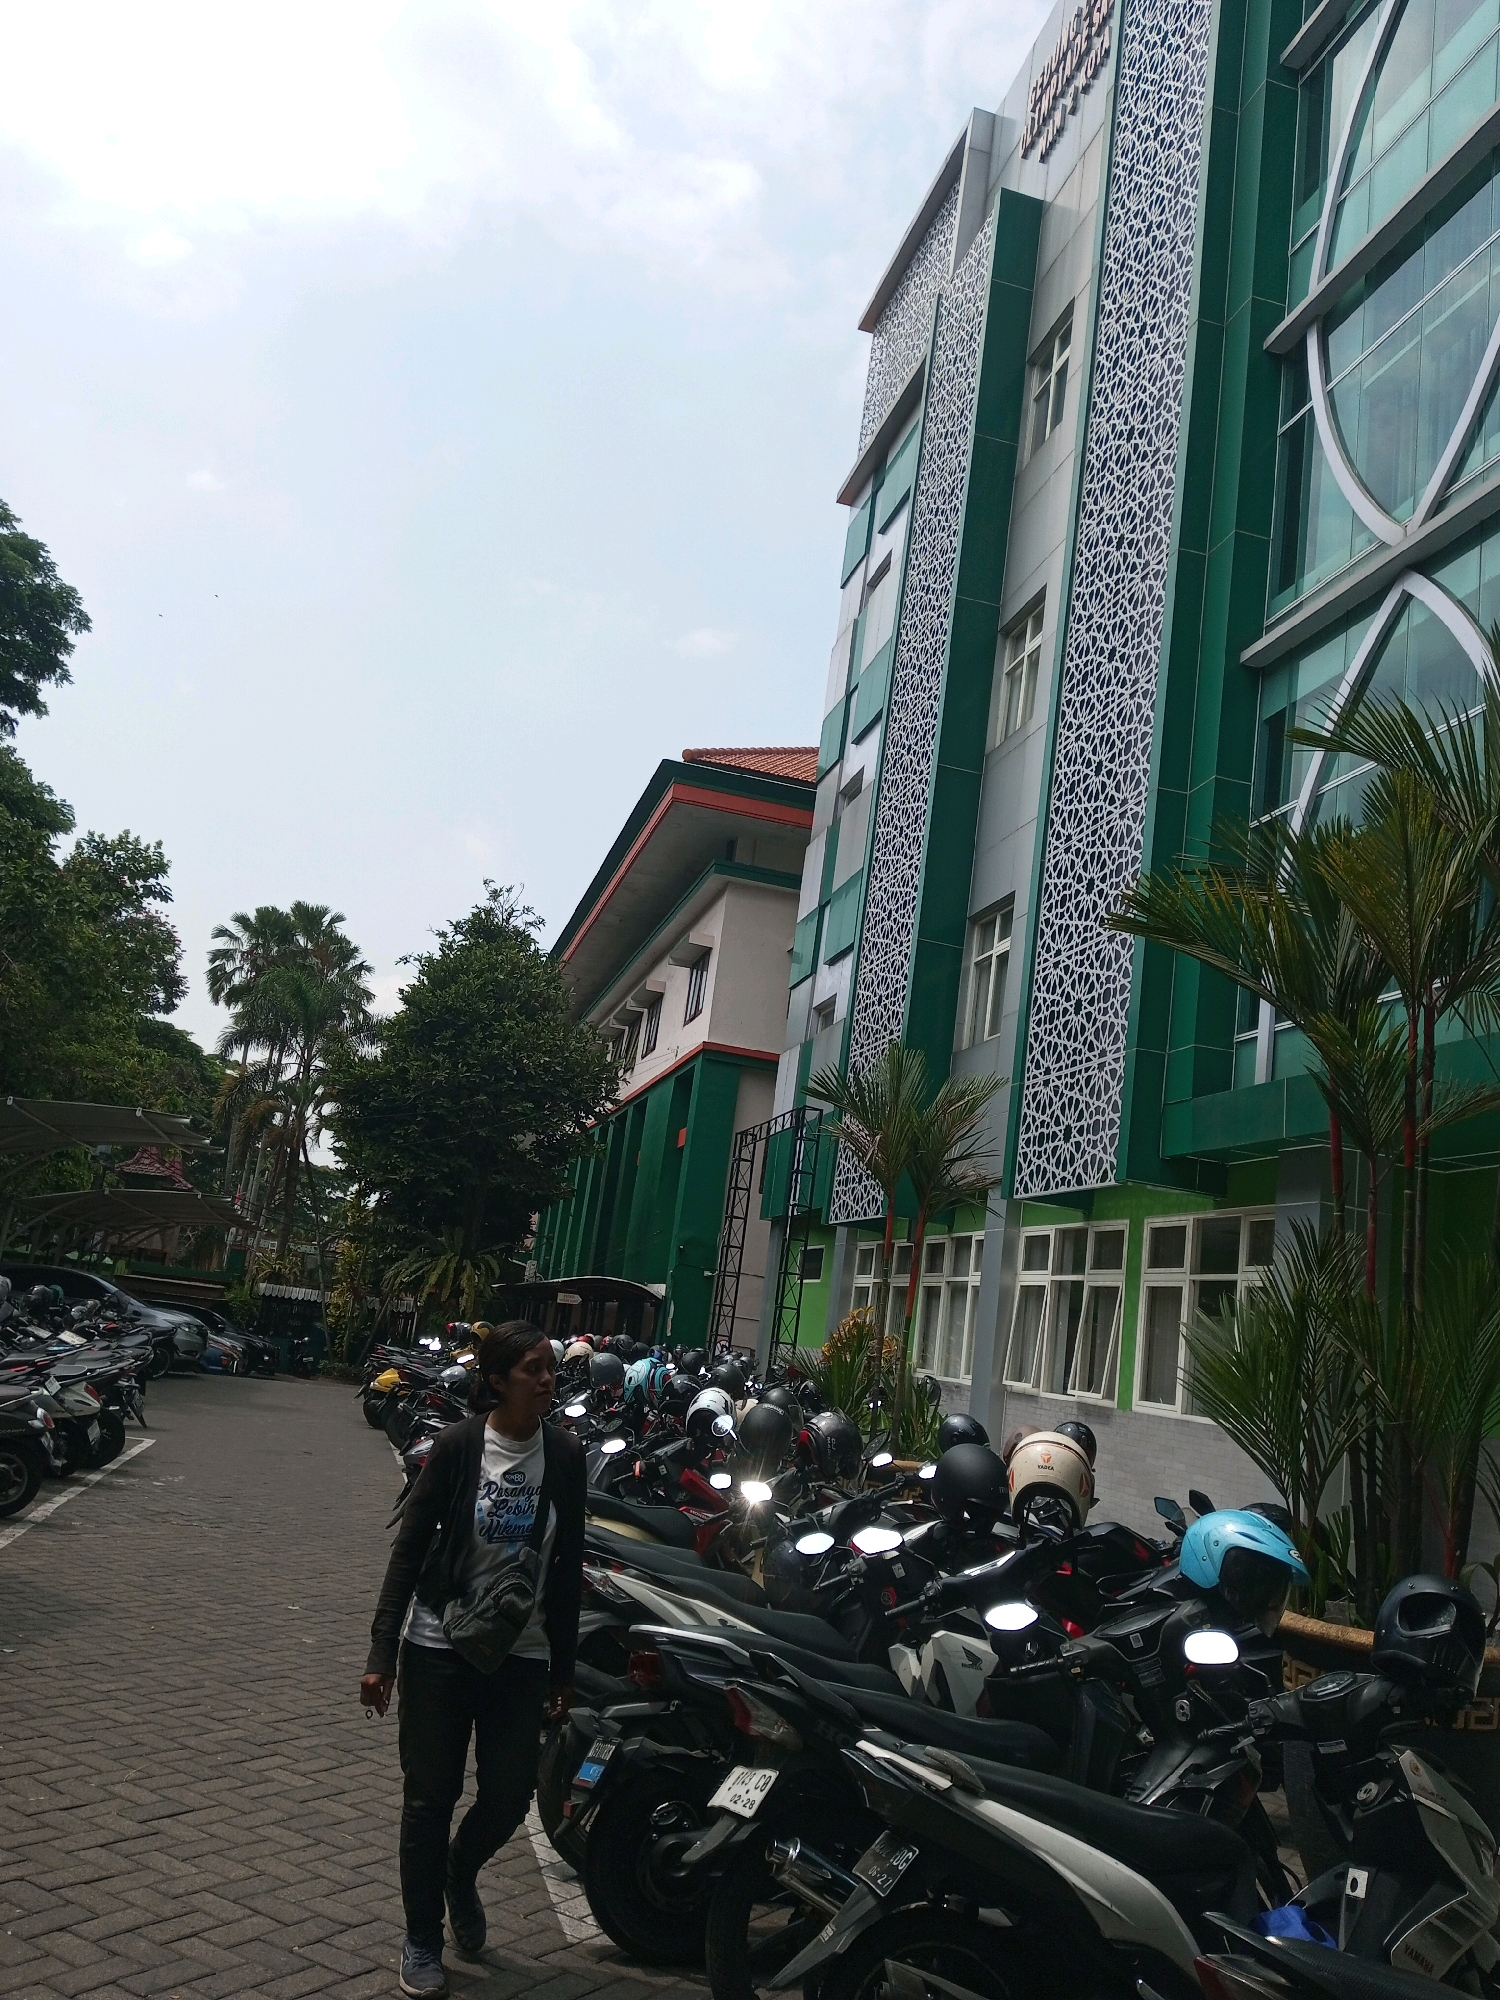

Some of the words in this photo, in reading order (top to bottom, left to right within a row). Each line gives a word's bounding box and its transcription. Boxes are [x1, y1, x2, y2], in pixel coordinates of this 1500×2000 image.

[1028, 5, 1082, 113] GEDUNG
[486, 1498, 537, 1519] Lebih
[478, 1518, 534, 1538] Nikma
[1403, 1943, 1435, 1976] YAMAHA
